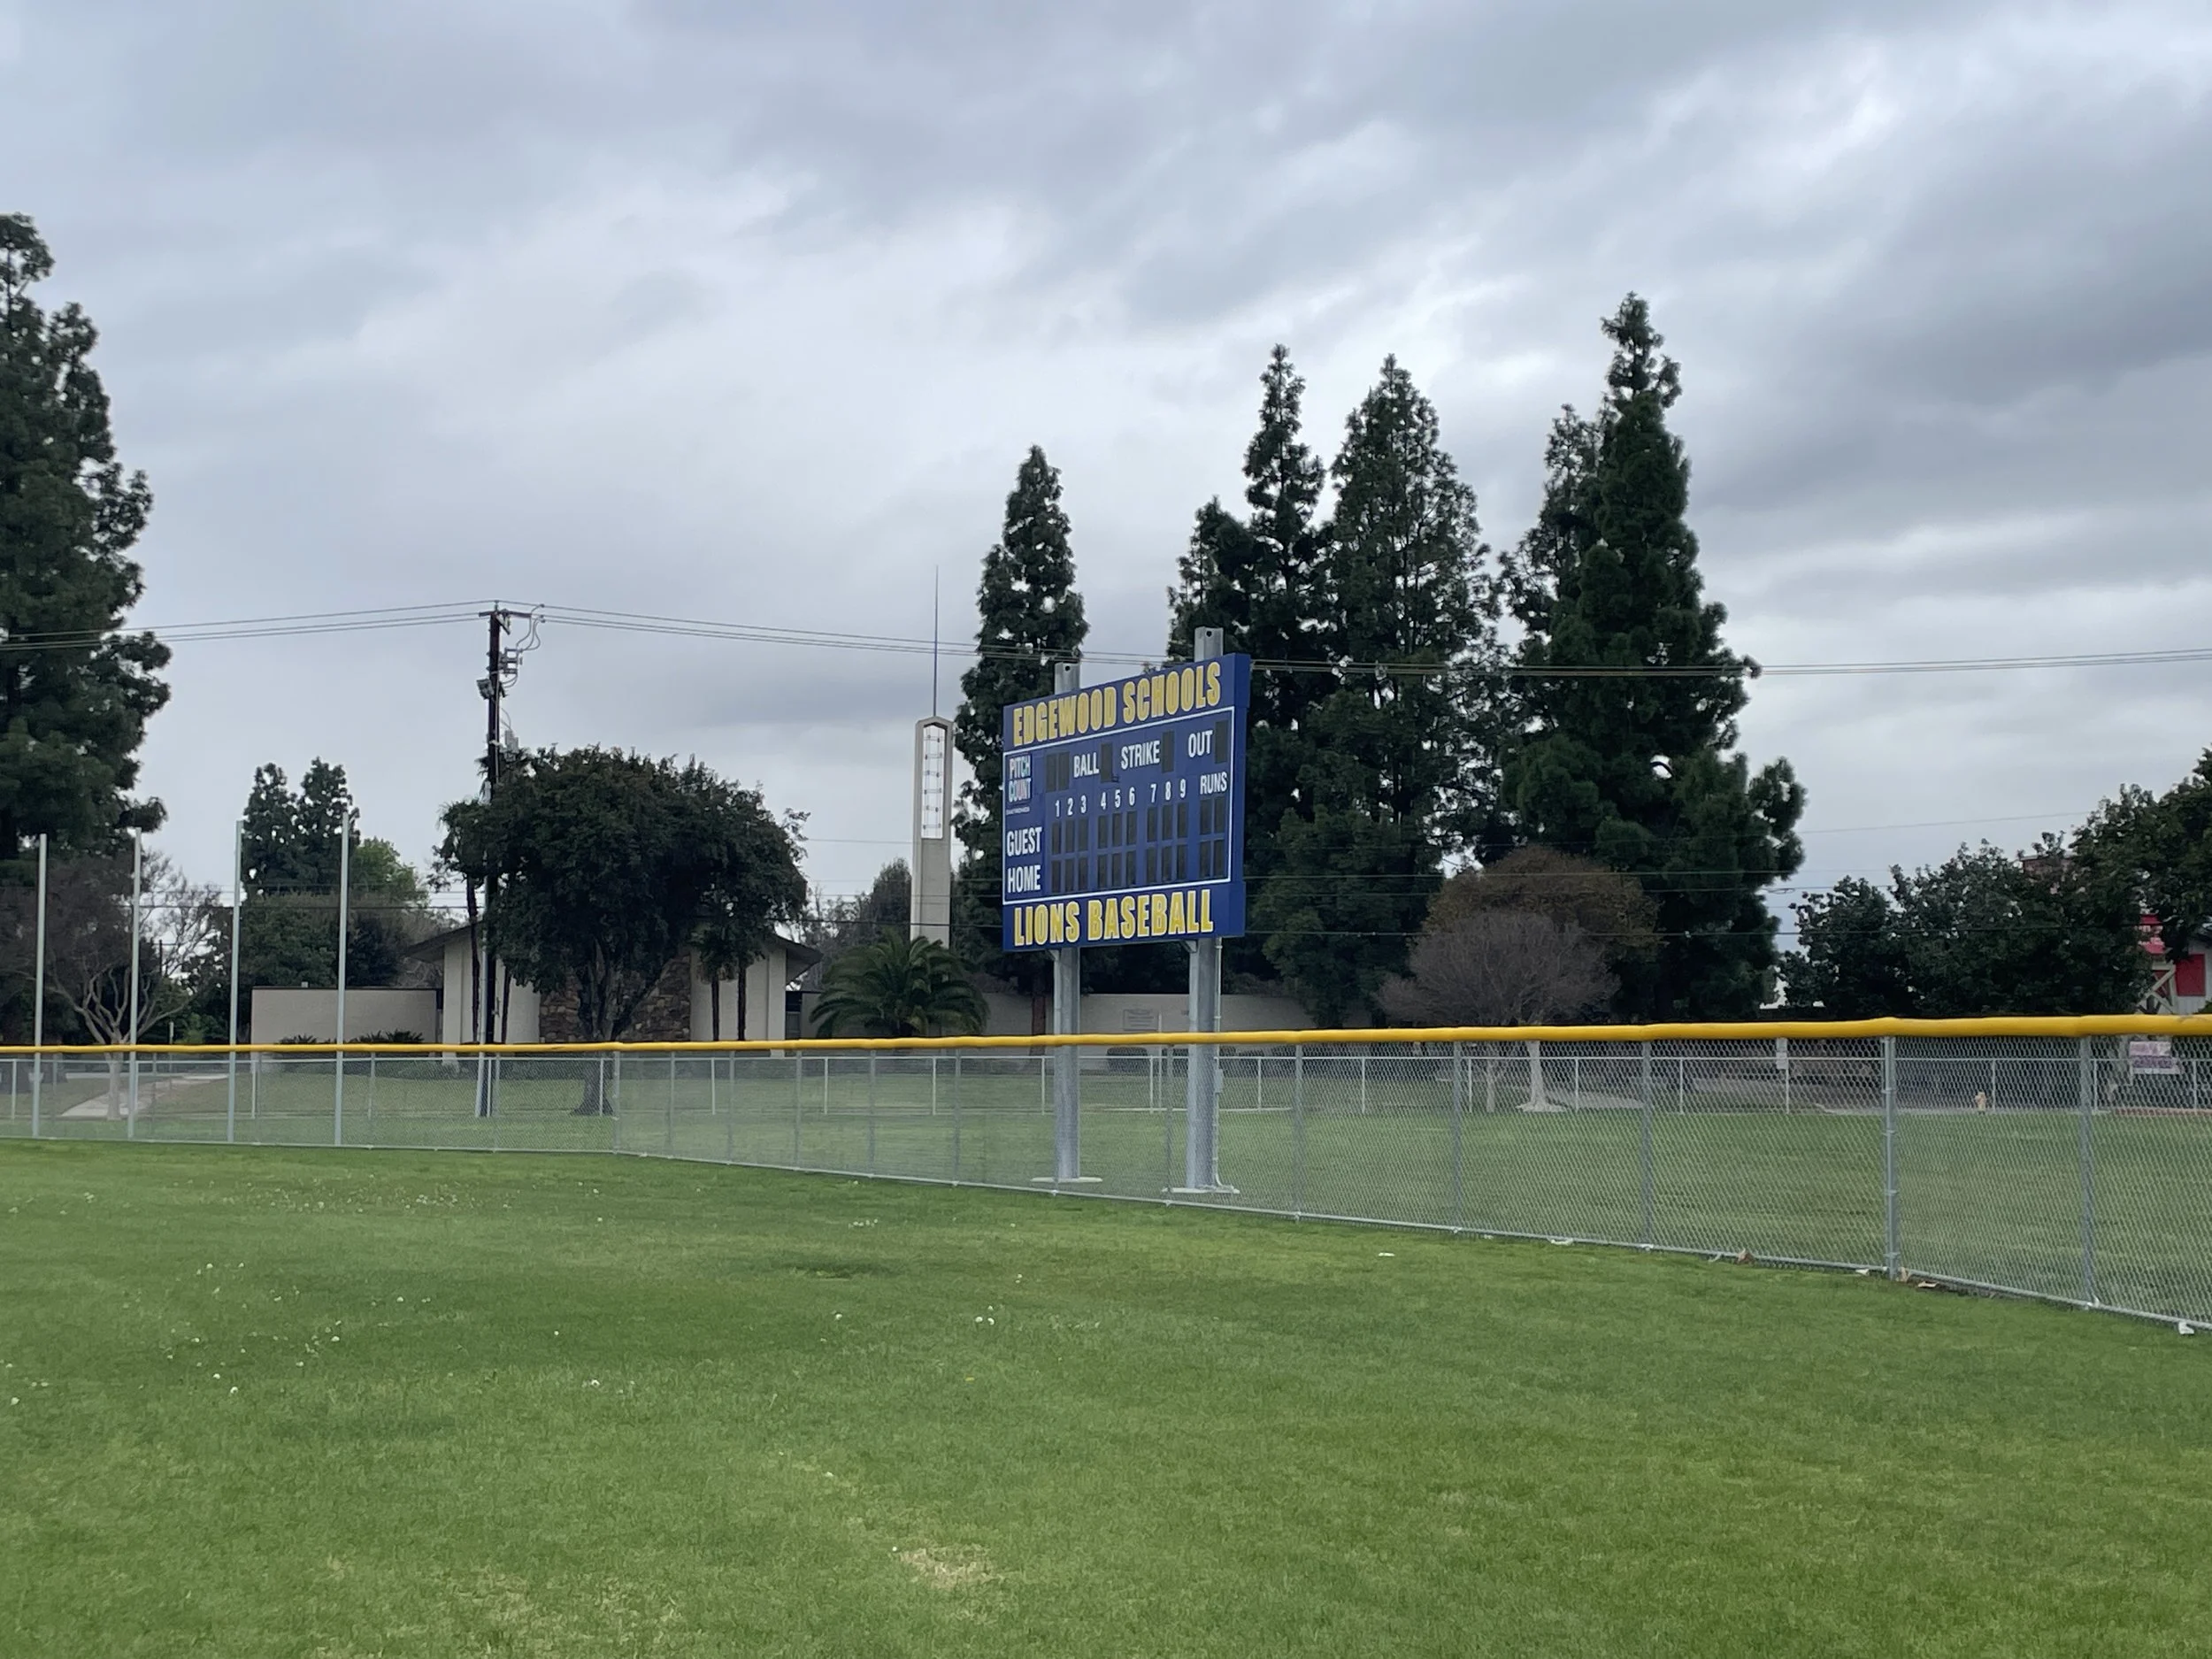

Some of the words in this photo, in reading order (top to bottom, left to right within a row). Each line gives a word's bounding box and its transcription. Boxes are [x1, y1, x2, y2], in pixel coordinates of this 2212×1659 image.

[1013, 686, 1117, 747] EDGEWOOD
[1123, 661, 1221, 725] SCHOOLS
[1120, 740, 1161, 770] STRIKE
[1188, 730, 1213, 758] OUT
[1009, 755, 1031, 780] PITCH
[1073, 752, 1100, 779] BALL
[1009, 778, 1032, 803] COUNT
[1055, 800, 1061, 818] 1
[1067, 797, 1073, 816] 2
[1080, 795, 1087, 814] 3
[1100, 791, 1107, 810] 4
[1114, 788, 1121, 808] 5
[1128, 787, 1135, 806] 6
[1150, 783, 1156, 803] 7
[1165, 780, 1171, 801] 8
[1179, 778, 1187, 798] 9
[1200, 772, 1227, 795] RUNS
[1007, 826, 1042, 856] GUEST
[1007, 864, 1041, 894] HOME
[1014, 901, 1080, 947] LIONS
[1087, 888, 1214, 941] BASEBALL
